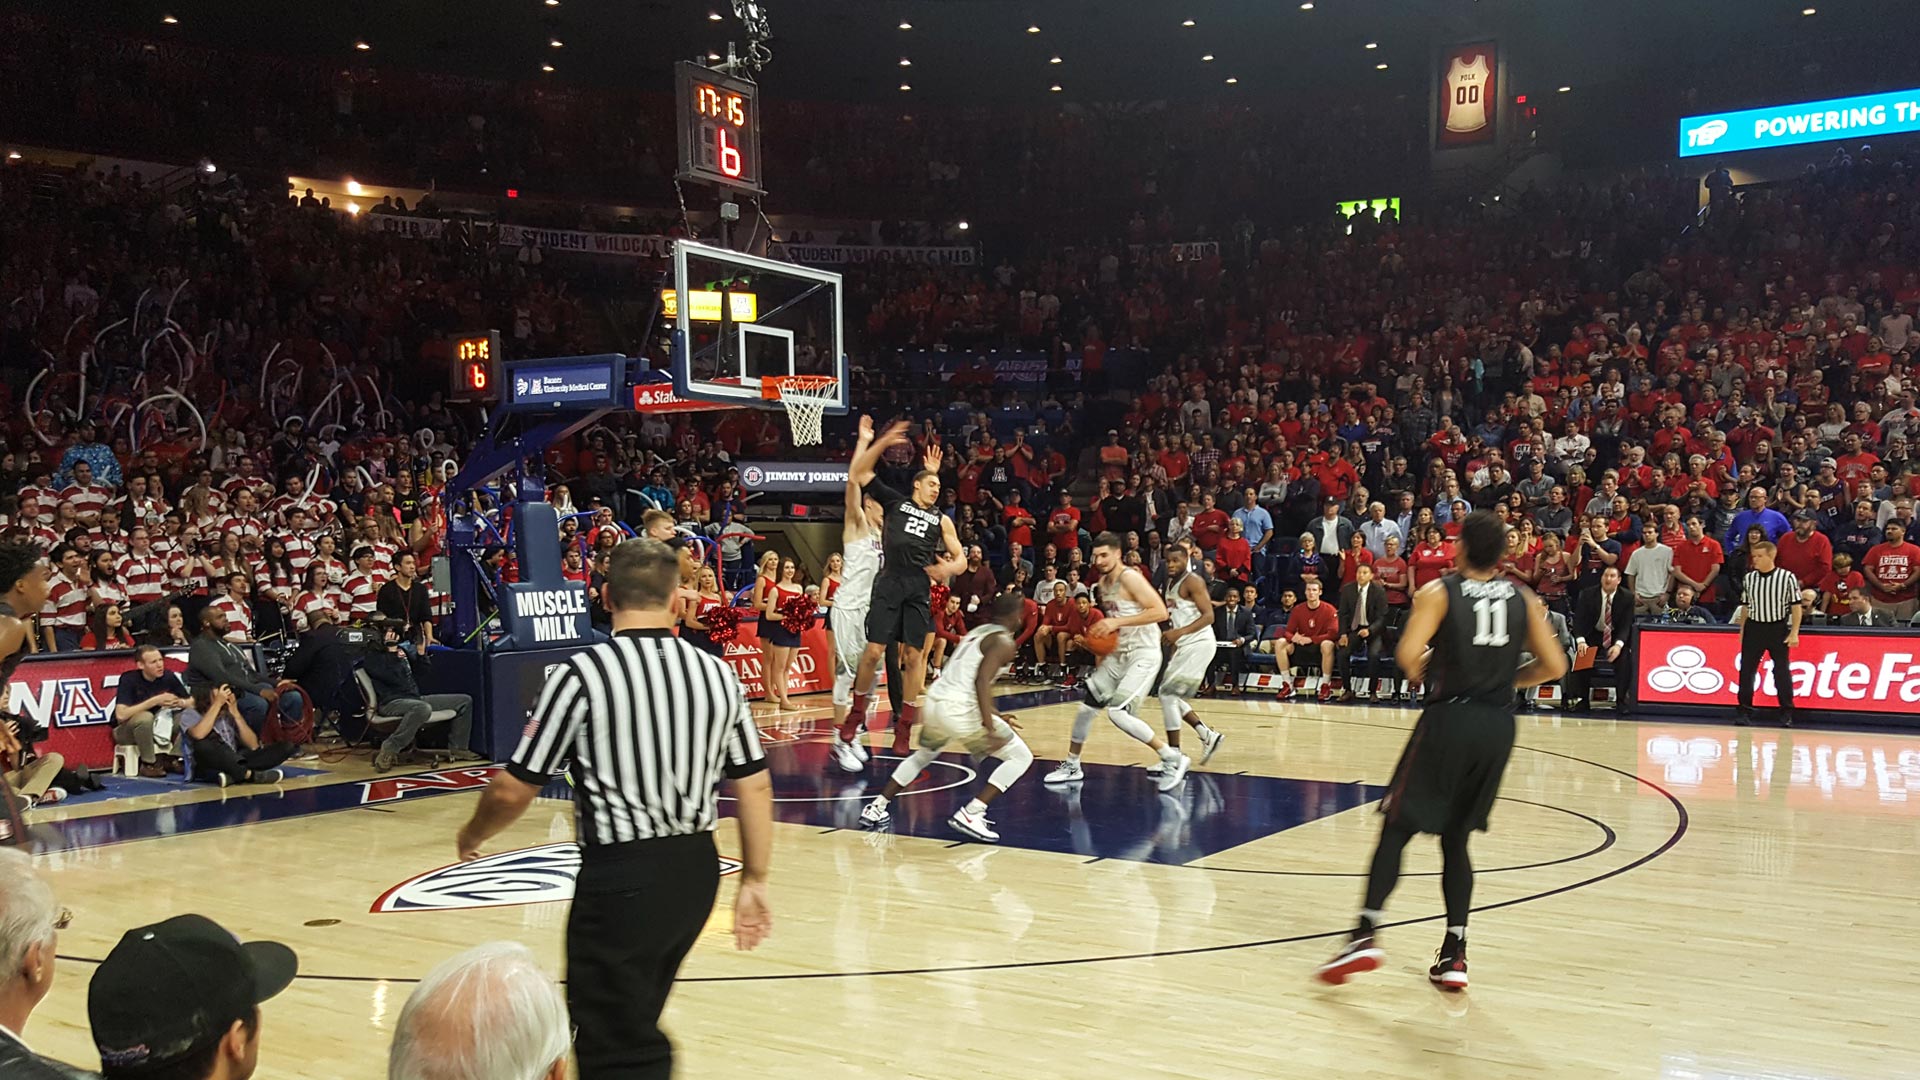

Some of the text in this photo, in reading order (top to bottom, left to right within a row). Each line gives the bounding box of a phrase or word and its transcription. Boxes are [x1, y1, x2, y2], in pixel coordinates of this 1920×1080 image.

[1456, 85, 1479, 105] 00
[698, 87, 745, 126] 17:15
[1688, 119, 1728, 147] TEP
[1754, 104, 1886, 139] POWERING
[594, 236, 658, 254] WILDCAT
[787, 247, 842, 262] STUDENT
[569, 384, 589, 392] Medical
[765, 471, 849, 484] JIMMY JOHN'S
[904, 516, 930, 539] 22
[516, 589, 587, 617] MUSCLE
[1472, 597, 1511, 647] 11
